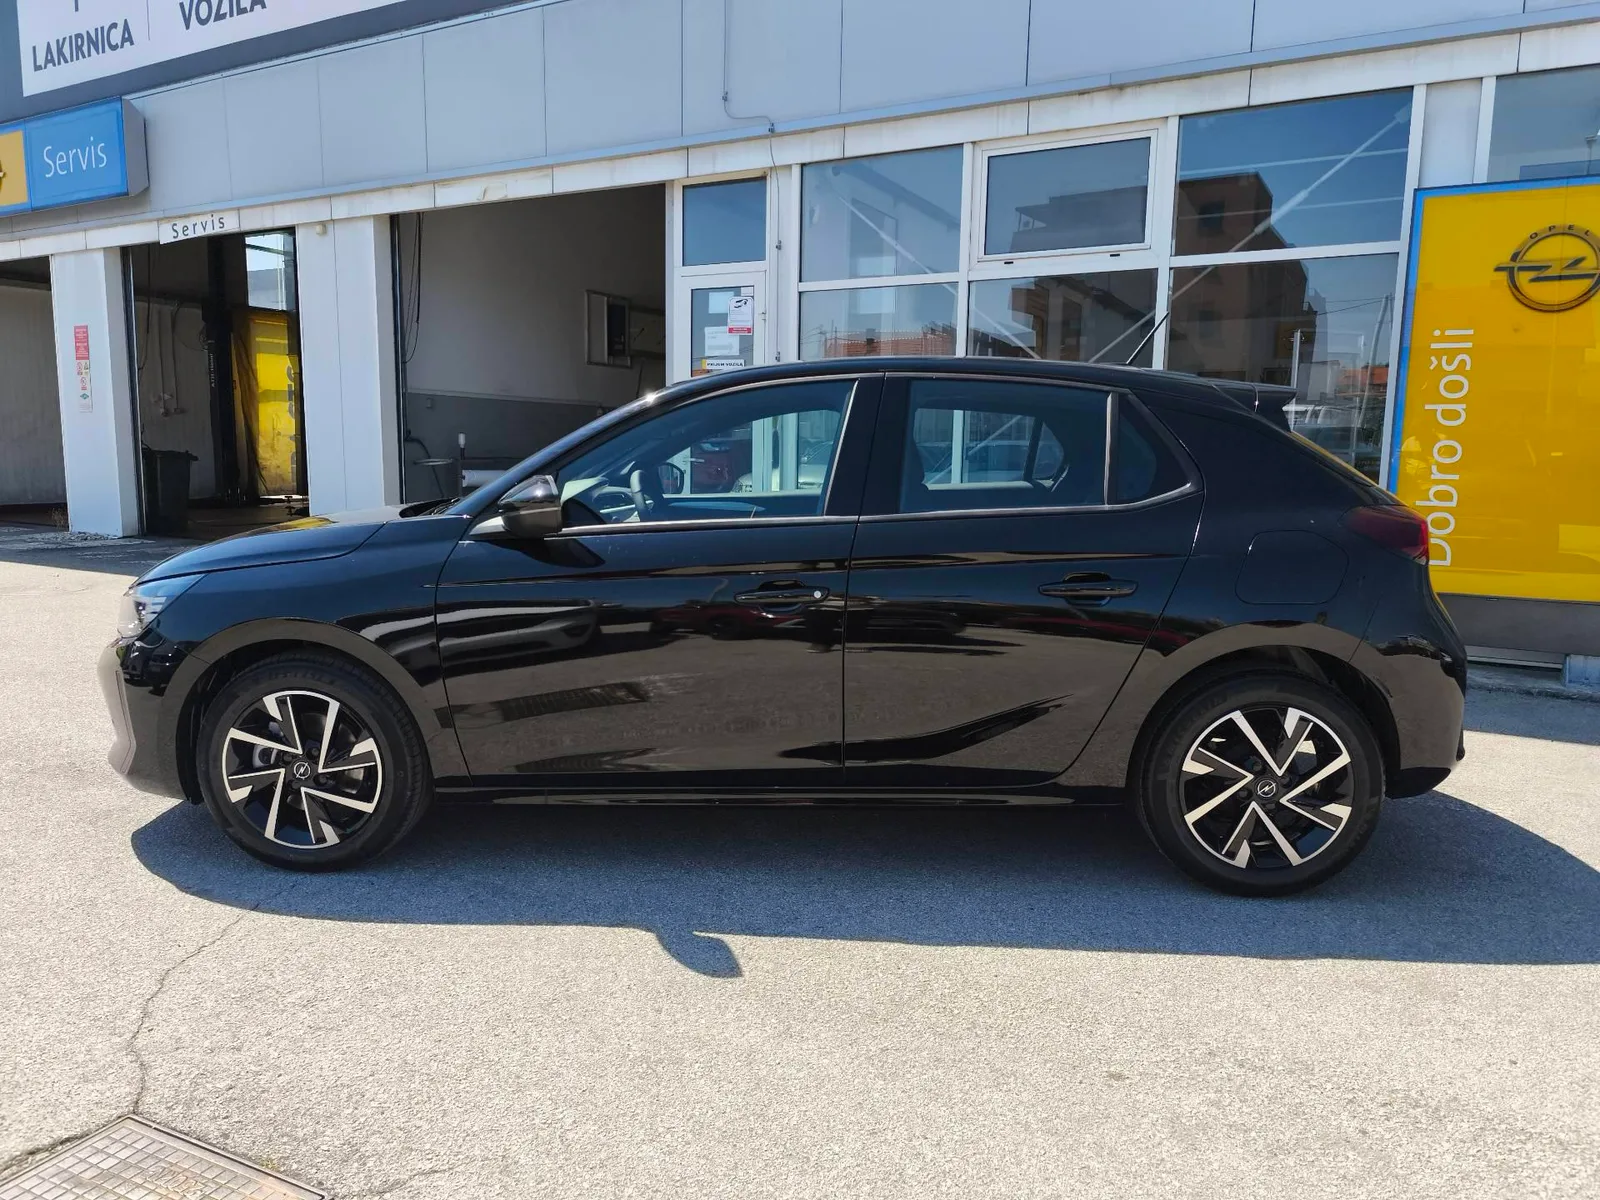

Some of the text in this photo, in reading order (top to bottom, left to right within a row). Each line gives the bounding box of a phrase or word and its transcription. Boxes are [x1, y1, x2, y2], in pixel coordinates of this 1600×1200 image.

[32, 18, 135, 73] LAKIRNICA
[43, 136, 108, 179] Servis
[171, 213, 226, 239] Servis
[1529, 224, 1591, 240] OPEL
[1415, 328, 1475, 567] Dobro došli
